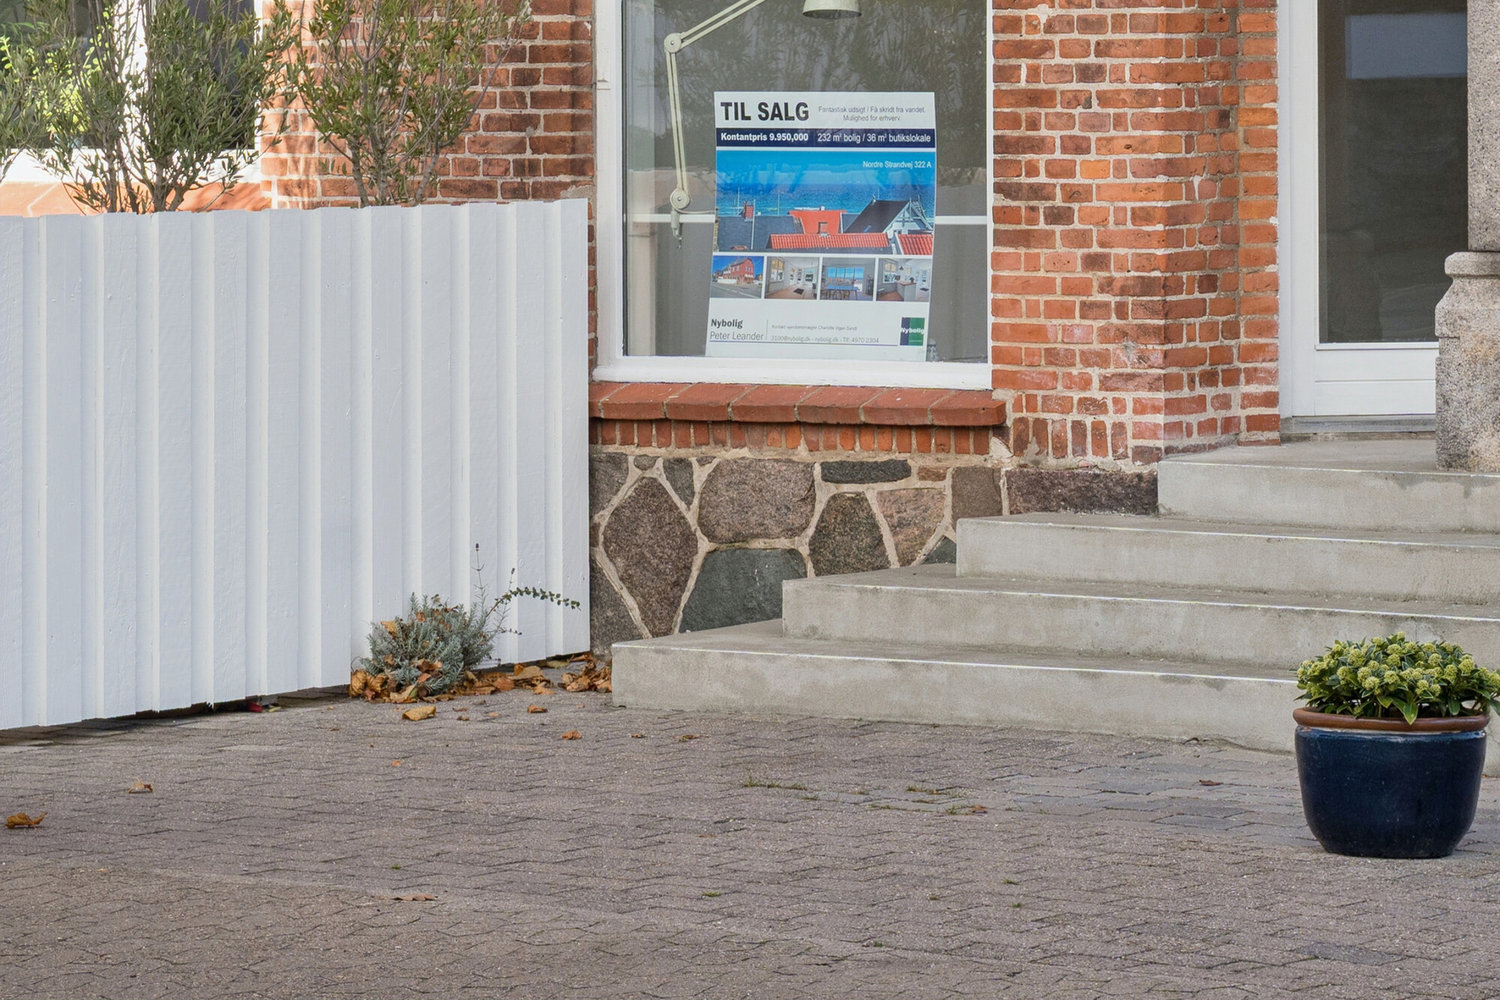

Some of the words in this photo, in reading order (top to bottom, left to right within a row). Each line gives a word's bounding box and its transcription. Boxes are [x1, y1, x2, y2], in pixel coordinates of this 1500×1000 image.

[720, 101, 752, 121] TIL
[757, 101, 810, 122] SALG
[818, 105, 846, 113] Fantastisk
[848, 105, 866, 114] udsigt
[870, 105, 878, 113] Få
[879, 105, 895, 113] skridt
[895, 105, 904, 113] fra
[843, 114, 869, 123] Mulighed
[870, 114, 878, 122] for
[720, 132, 768, 143] Kontantpris
[769, 132, 809, 143] 9.950,000
[817, 133, 831, 142] 232
[843, 133, 861, 144] bolig
[866, 133, 877, 142] 36
[888, 133, 931, 143] butikslokale
[862, 160, 884, 168] Nordre
[884, 160, 913, 170] Strandvej
[913, 160, 926, 168] 322
[710, 318, 744, 330] Nybolig
[710, 330, 730, 340] Peter
[732, 331, 764, 341] Leander
